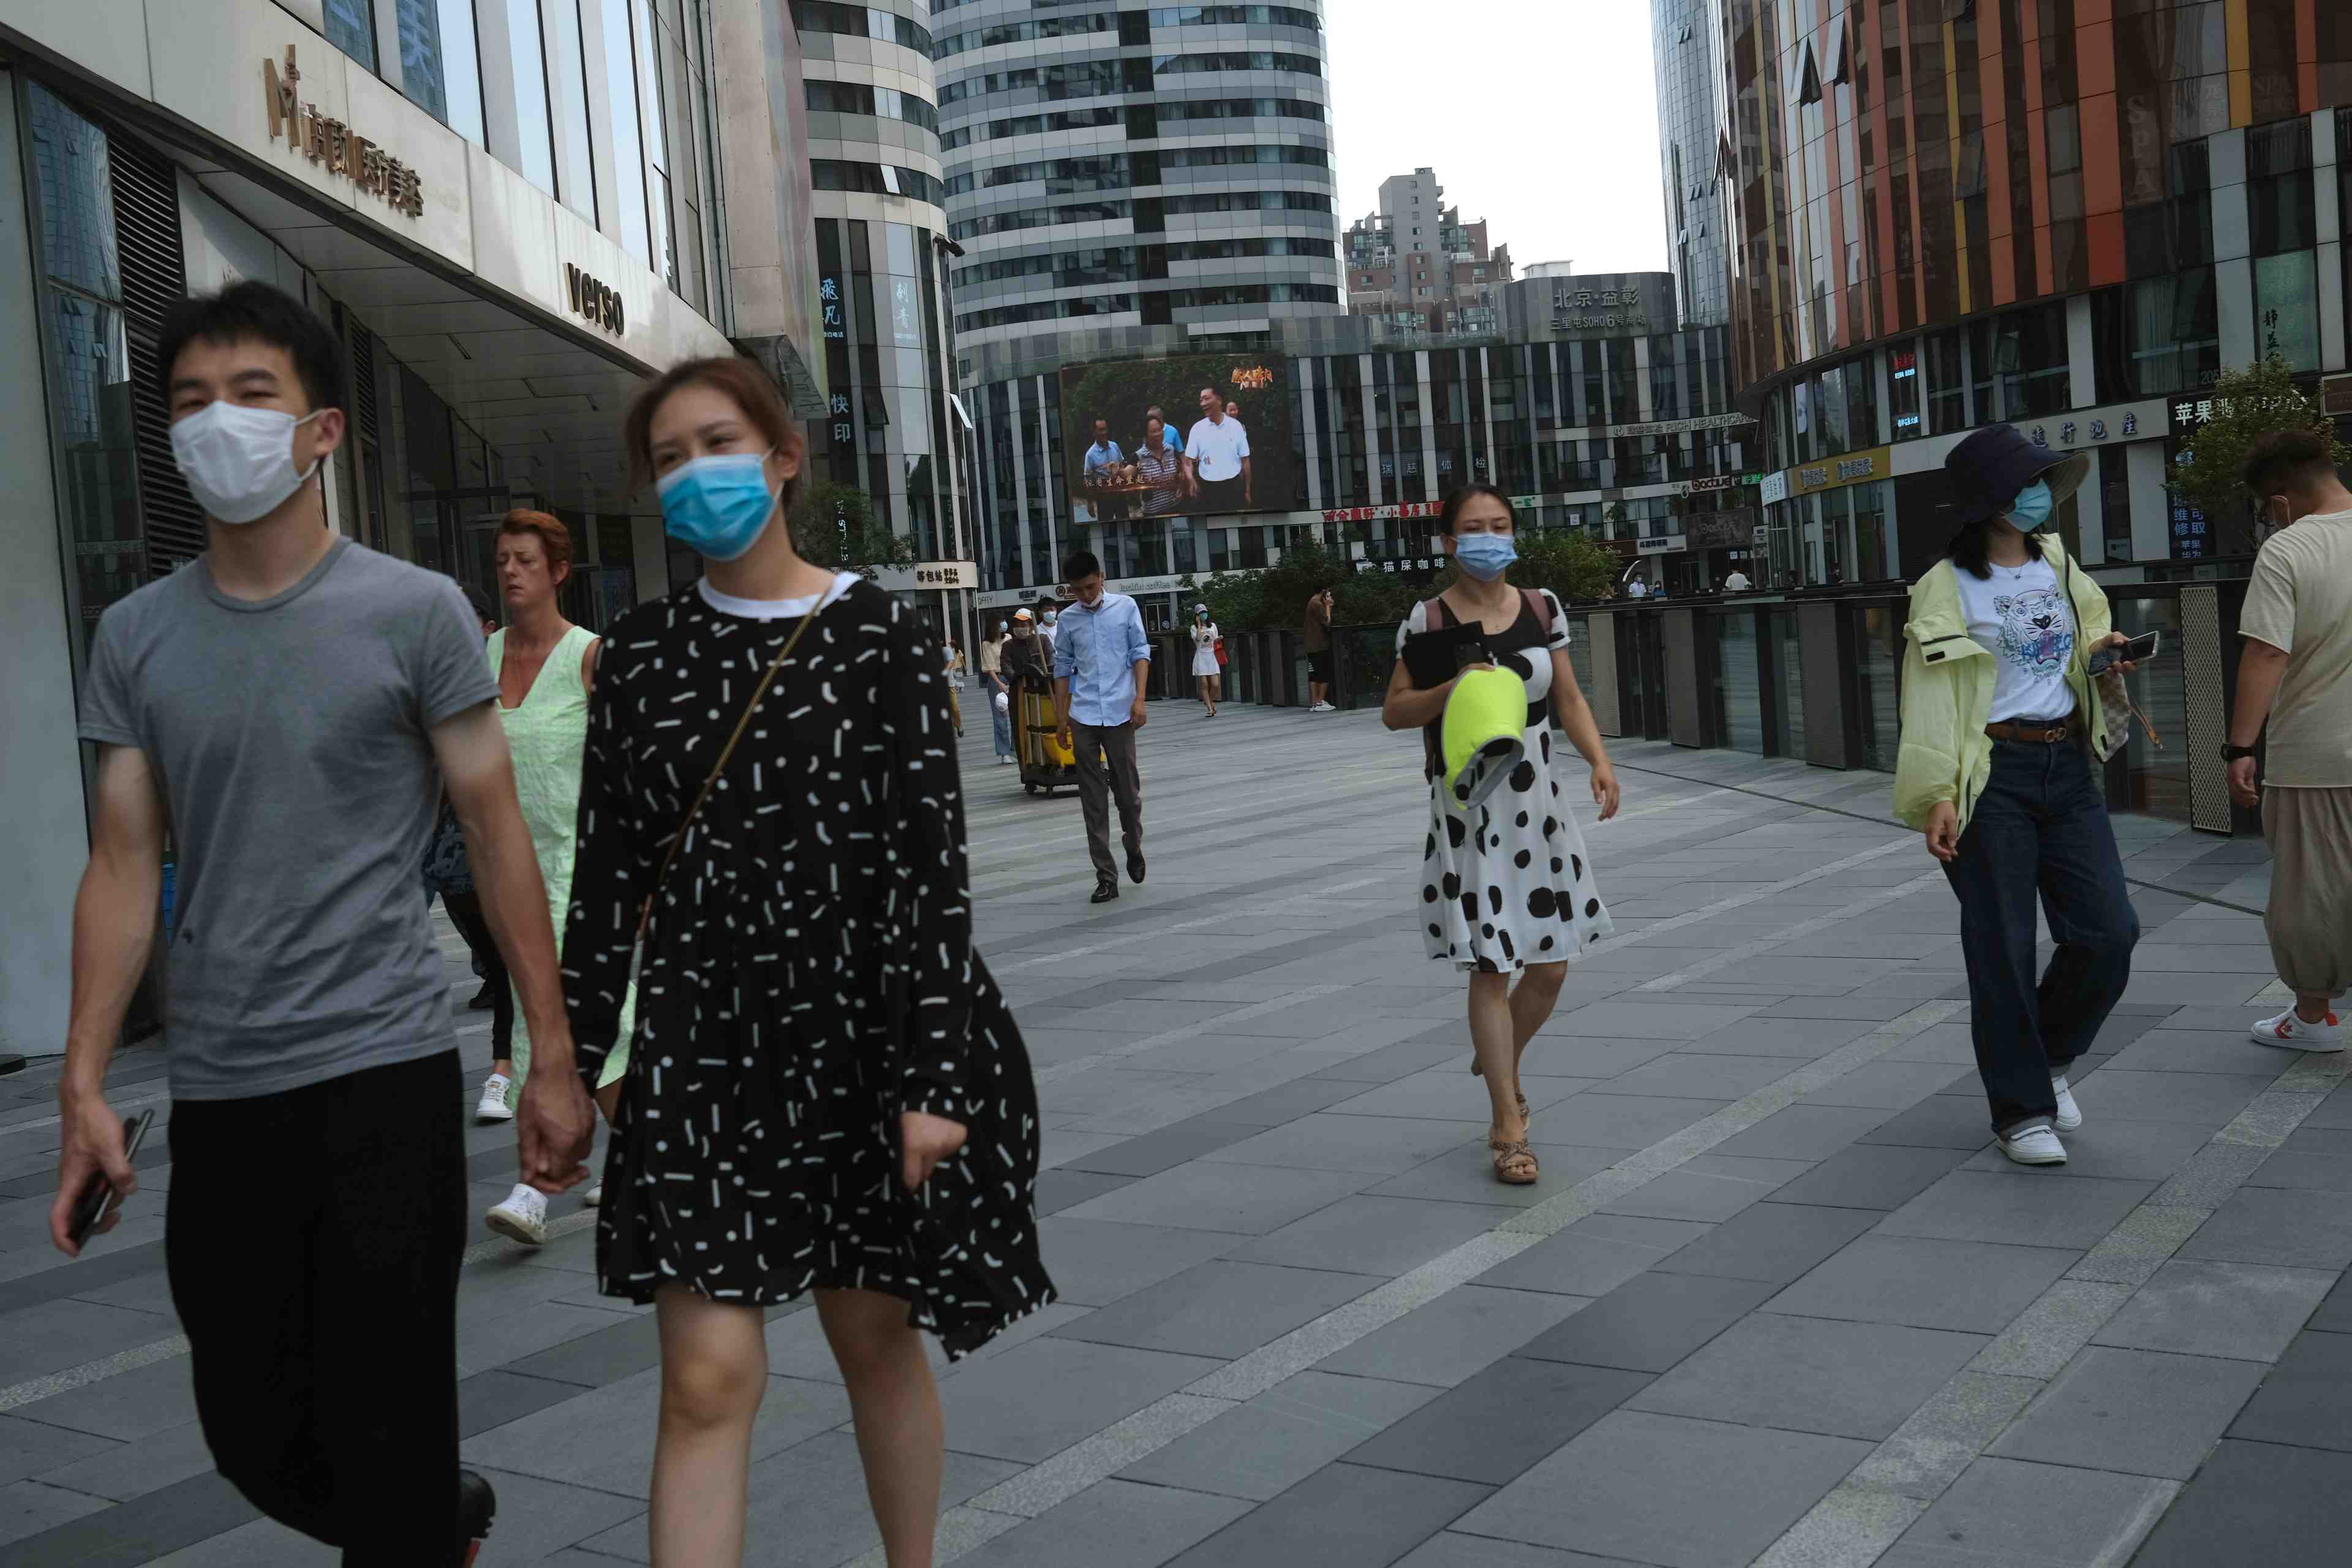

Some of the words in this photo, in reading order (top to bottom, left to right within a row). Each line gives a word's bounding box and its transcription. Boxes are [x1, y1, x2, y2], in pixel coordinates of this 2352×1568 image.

[563, 262, 625, 336] verso
[831, 393, 850, 442] 快印
[1665, 420, 1691, 432] RICH
[1383, 558, 1446, 573] 猫屎咖啡
[1145, 580, 1172, 590] coffee
